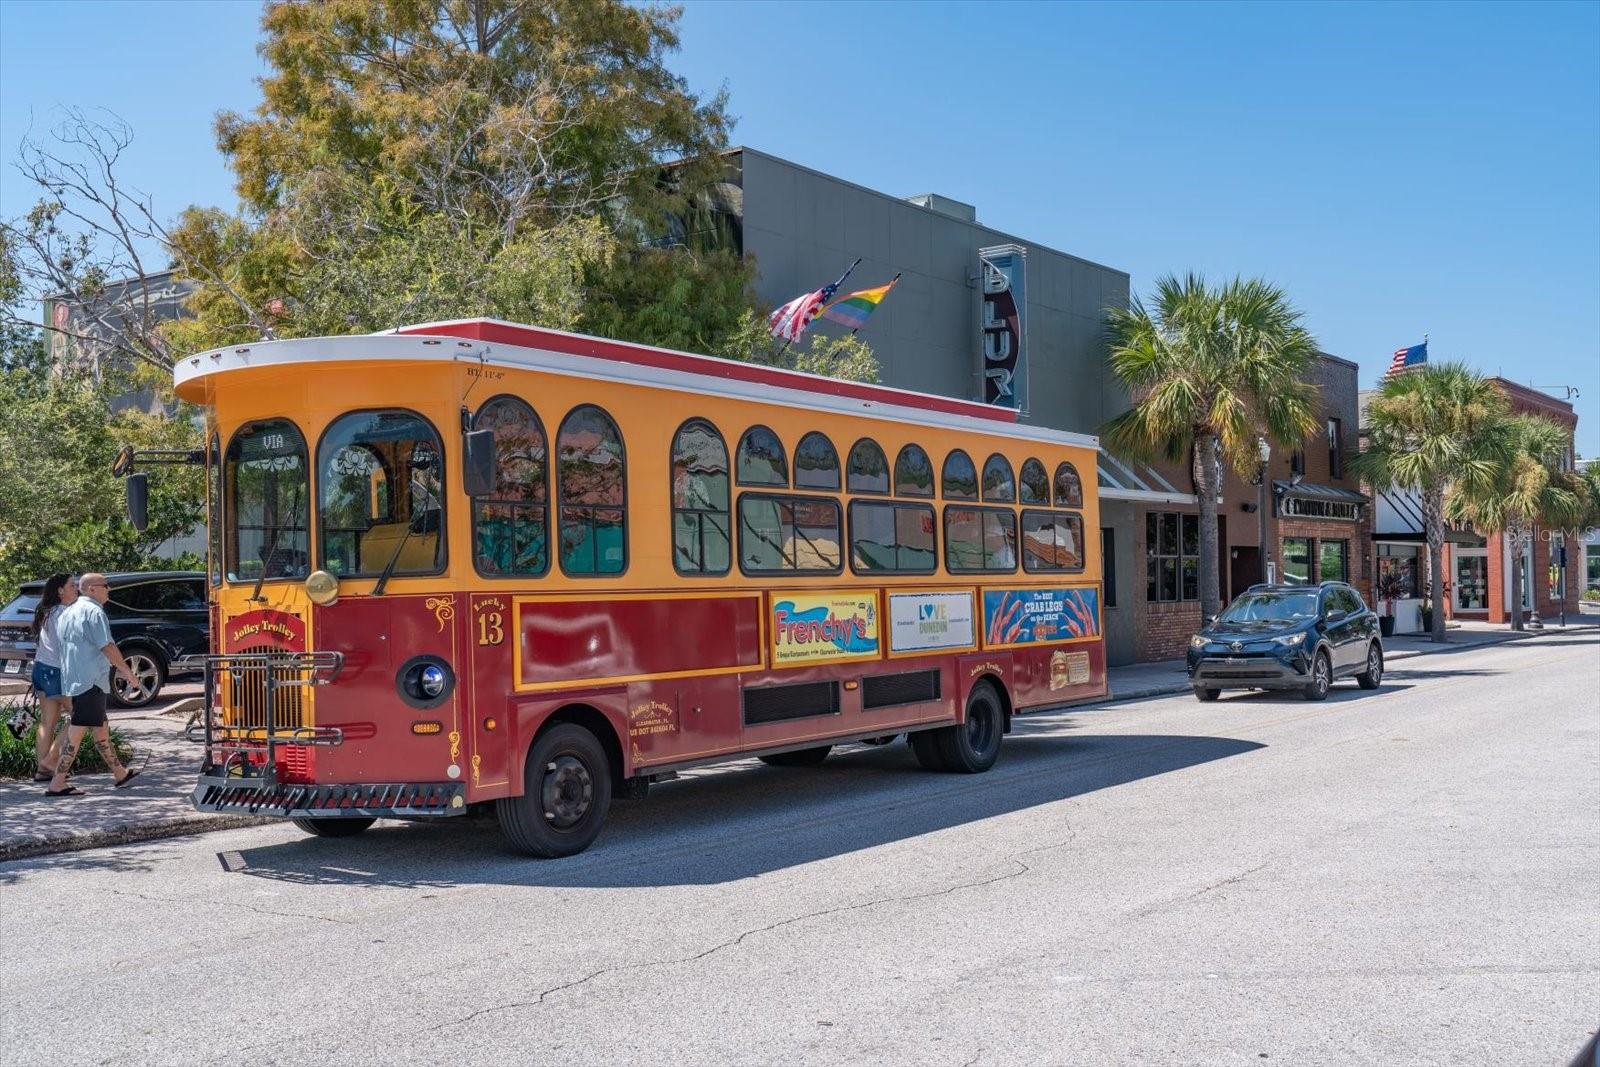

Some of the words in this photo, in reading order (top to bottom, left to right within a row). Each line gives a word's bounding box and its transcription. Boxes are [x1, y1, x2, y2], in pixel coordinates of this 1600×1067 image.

[984, 264, 1012, 404] BLUR
[263, 434, 284, 449] VIA
[473, 598, 506, 611] Lucky
[1024, 601, 1045, 613] CRAB
[1045, 600, 1063, 612] LEGS
[233, 623, 260, 641] Jolley
[262, 620, 296, 641] Trolley
[479, 612, 504, 645] 13
[775, 609, 866, 647] Frenchy's
[919, 620, 948, 634] DUNEDIN
[986, 662, 1004, 675] Trolley
[650, 700, 673, 716] Trolley
[638, 727, 649, 735] DOT
